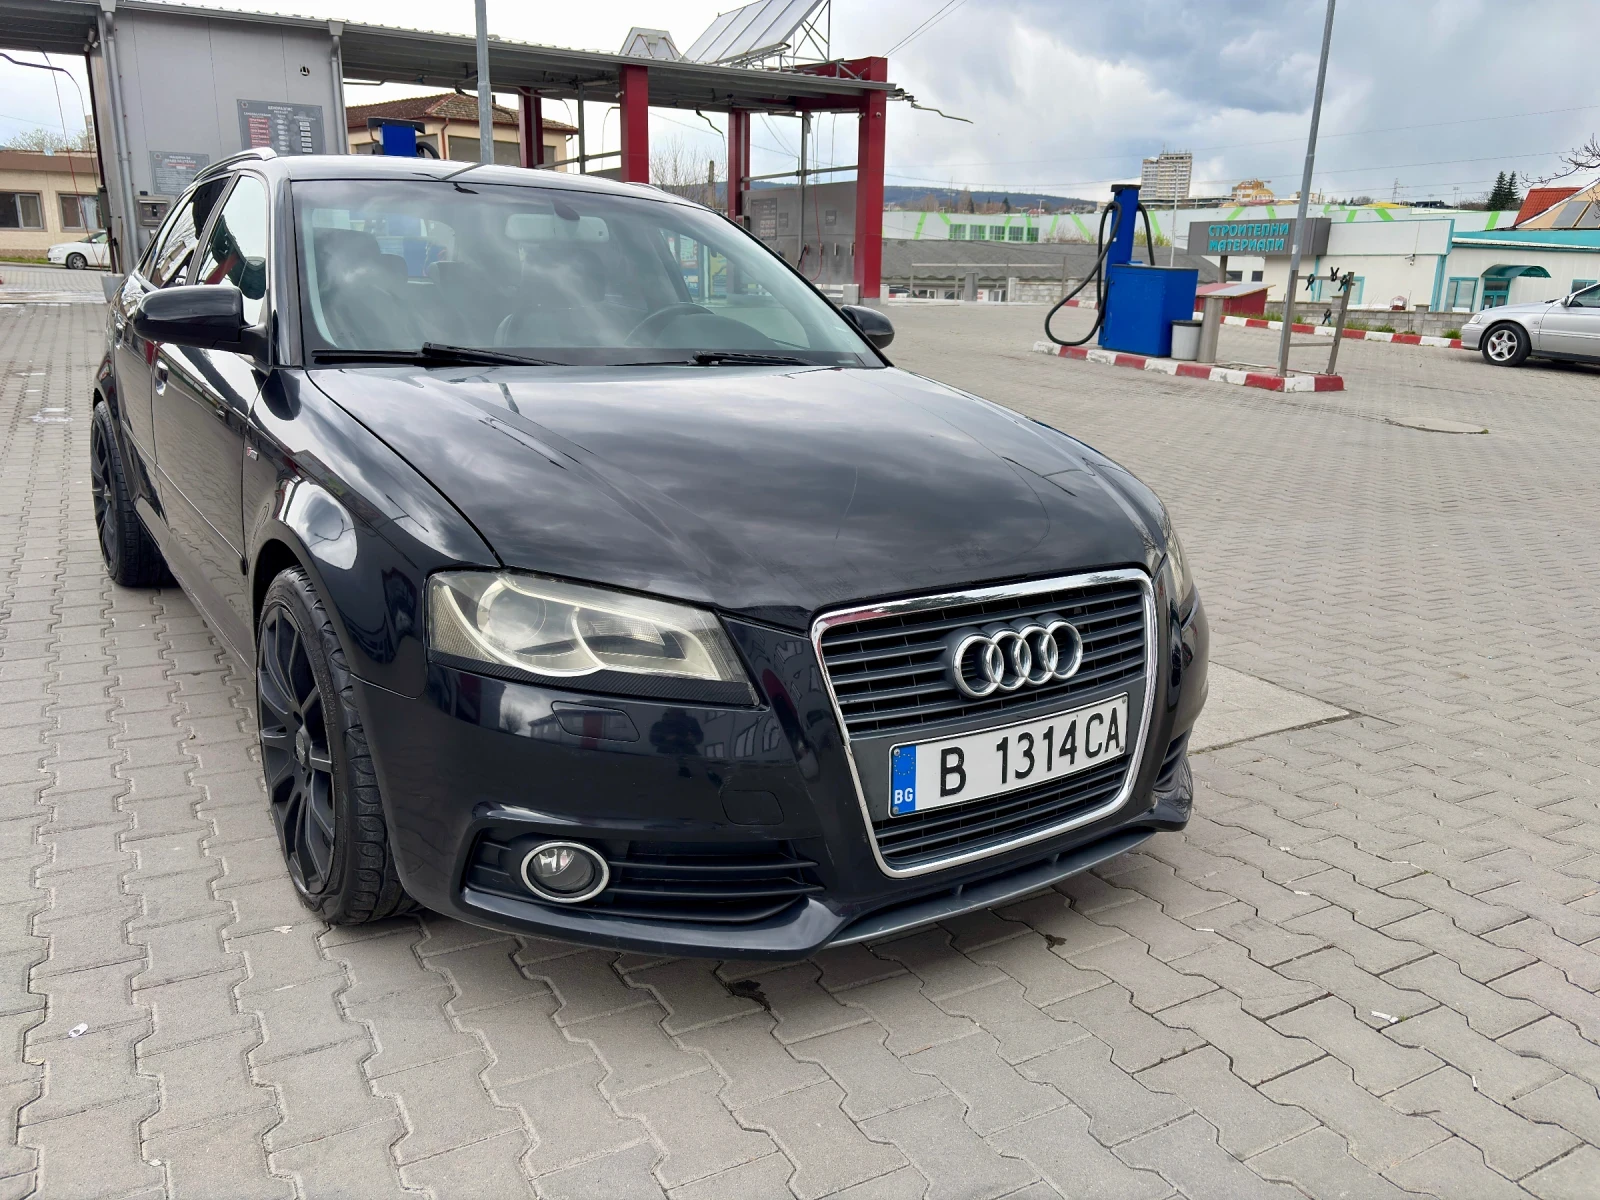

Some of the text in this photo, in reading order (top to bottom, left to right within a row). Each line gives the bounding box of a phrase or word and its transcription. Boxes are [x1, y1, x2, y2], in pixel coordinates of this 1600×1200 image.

[1208, 223, 1289, 237] СТРОИТЕЛНИ
[1208, 238, 1284, 252] МАТЕРИАЛИ
[940, 746, 967, 797] B
[894, 787, 914, 805] BG
